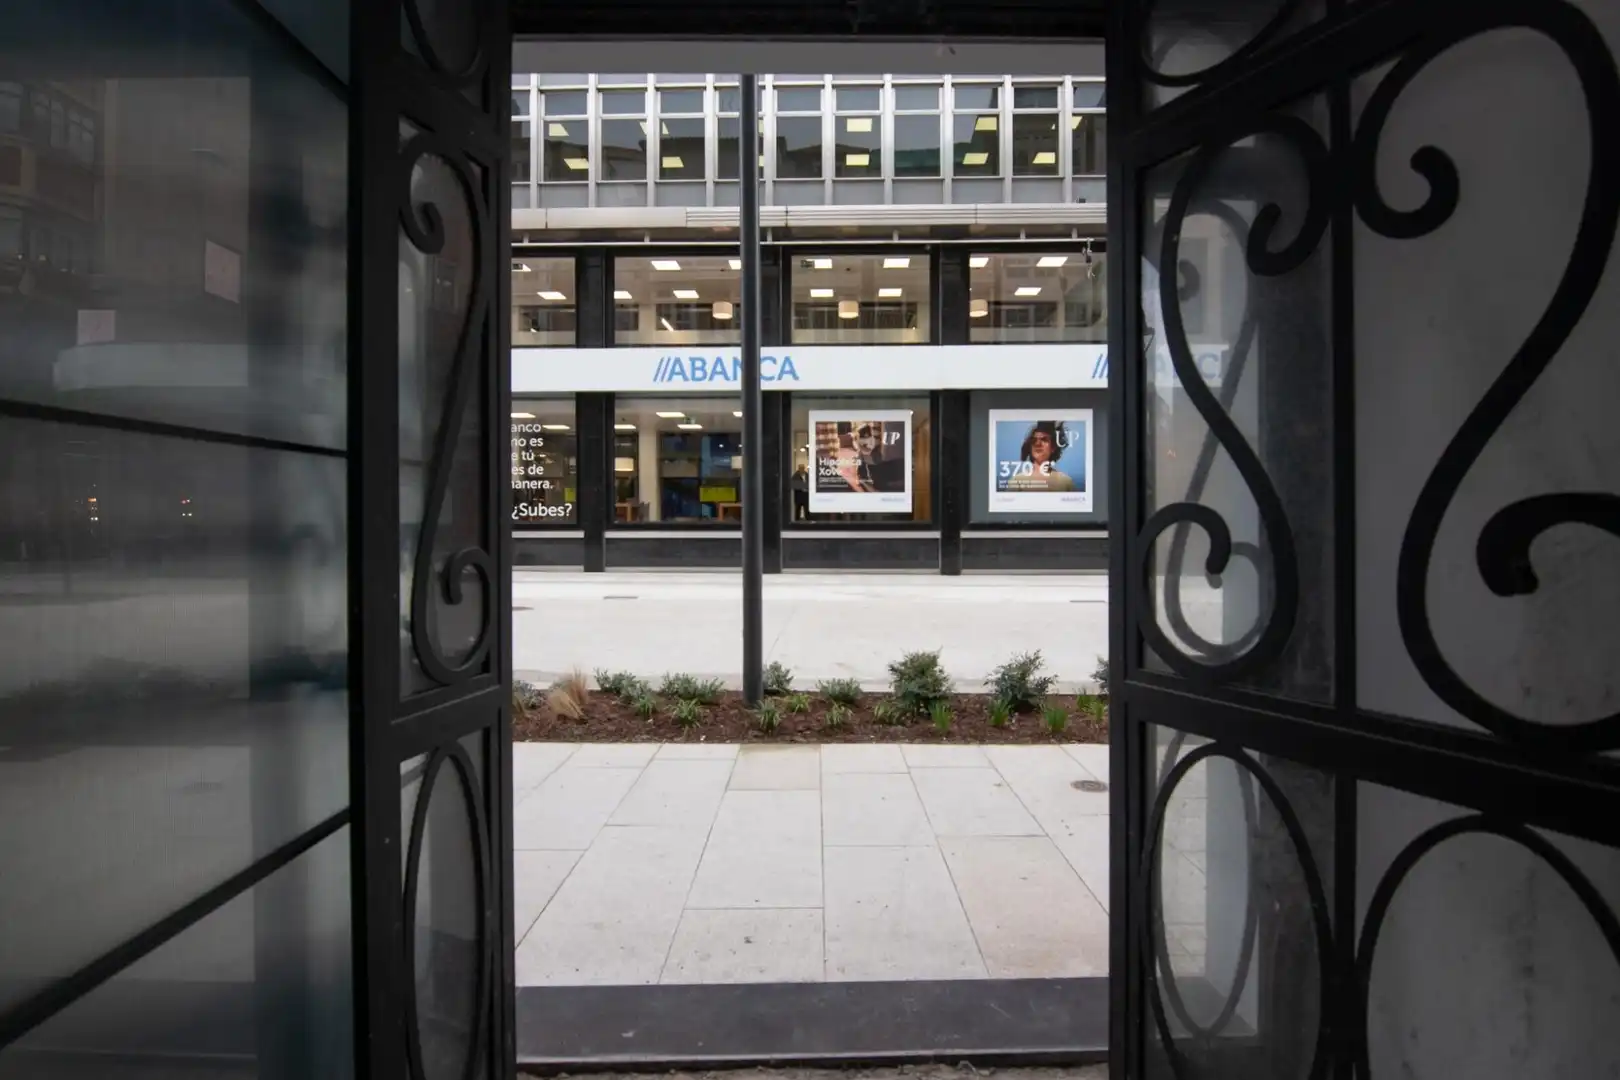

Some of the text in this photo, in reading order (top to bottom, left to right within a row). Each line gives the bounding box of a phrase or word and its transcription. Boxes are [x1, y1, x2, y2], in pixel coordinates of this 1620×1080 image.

[529, 437, 544, 447] es
[1055, 430, 1080, 448] UP
[527, 463, 544, 475] de
[999, 460, 1034, 477] 370
[511, 502, 573, 520] ¿Subes?
